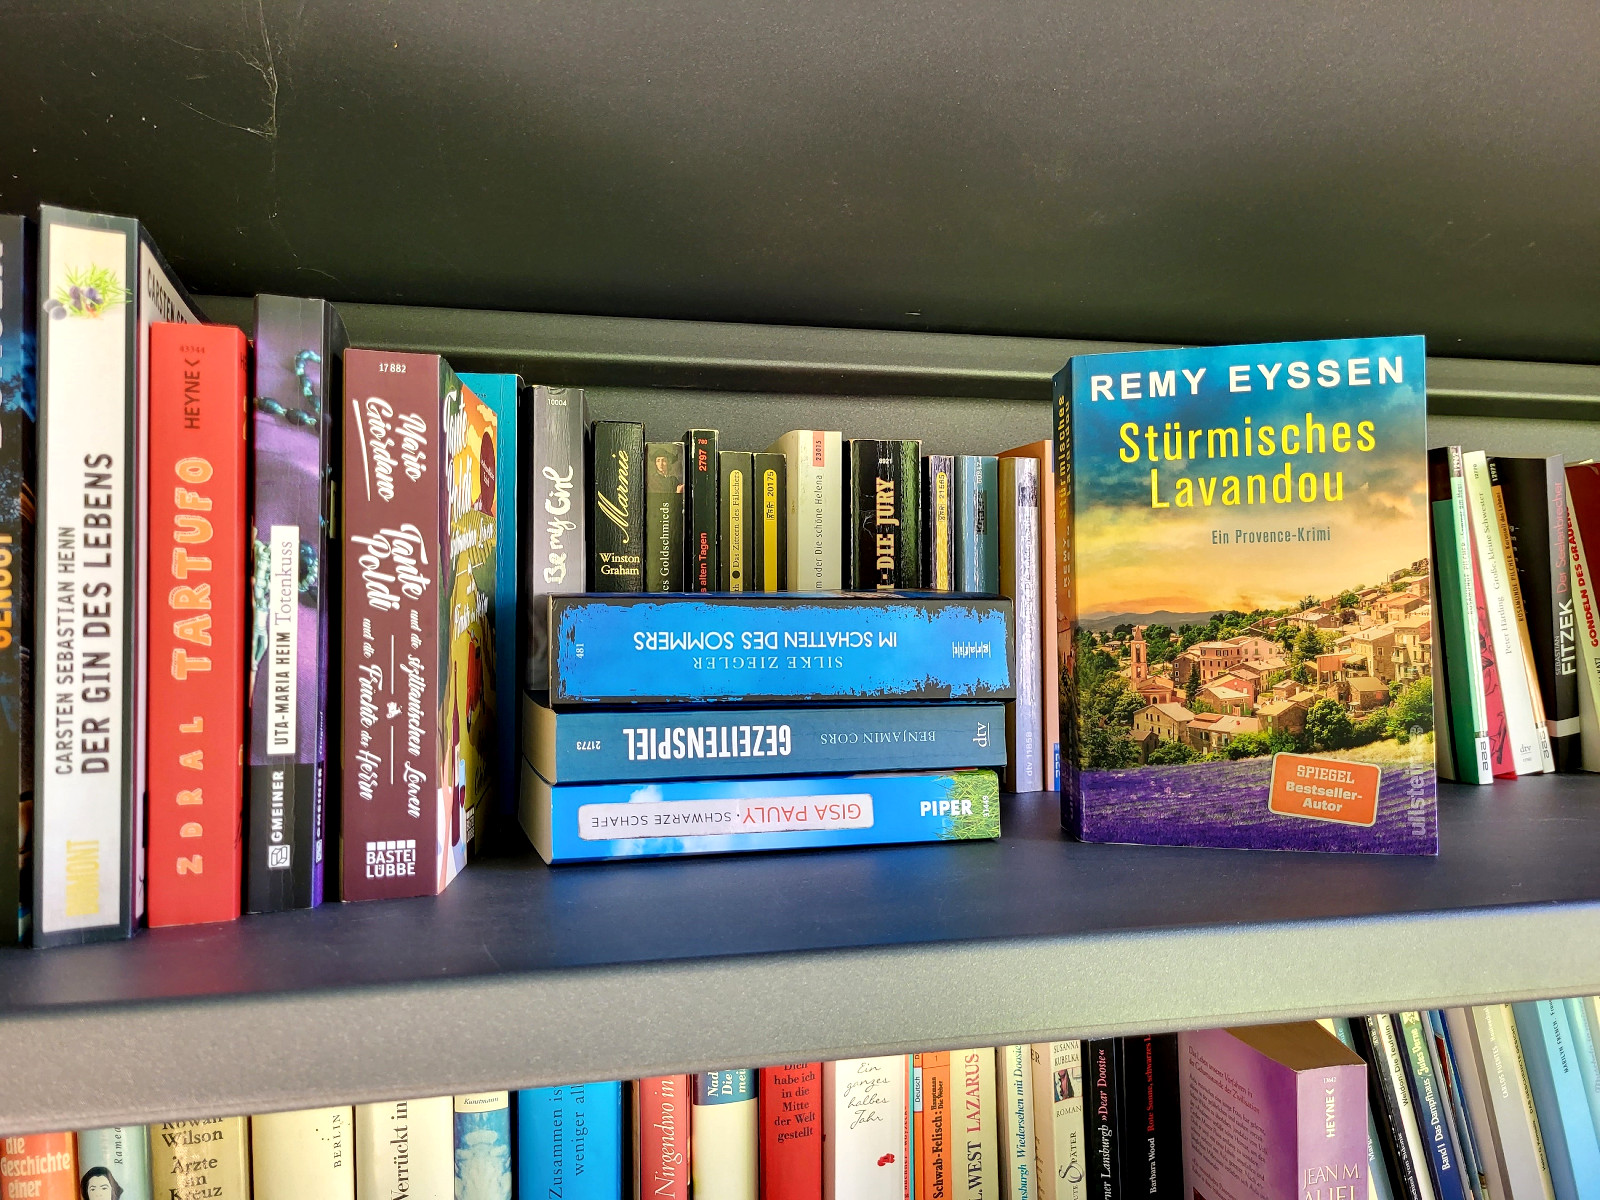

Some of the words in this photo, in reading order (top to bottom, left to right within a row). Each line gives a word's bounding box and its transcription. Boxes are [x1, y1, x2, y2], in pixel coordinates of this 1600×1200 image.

[1091, 368, 1207, 401] REMY
[1229, 356, 1403, 393] EYSSEN
[185, 371, 200, 429] HEYNE
[365, 397, 399, 502] Giordano
[395, 413, 427, 483] Mario
[1119, 412, 1377, 463] Stürmisches
[699, 449, 708, 471] 2797
[542, 465, 574, 516] Girl
[767, 471, 775, 497] 20175
[815, 474, 823, 505] Helena
[1150, 463, 1345, 509] Lavandou
[597, 450, 630, 544] Marnie
[876, 476, 899, 527] JURY
[84, 453, 113, 568] LEBENS
[732, 513, 740, 528] des
[815, 506, 823, 537] schöne
[1478, 492, 1492, 534] Schwester
[546, 516, 577, 551] my
[1212, 530, 1230, 544] Ein
[1235, 526, 1331, 544] Provence-Krimi
[1551, 481, 1567, 568] Seelenbrecher
[58, 527, 75, 573] HENN
[659, 502, 670, 580] Goldschmieds
[699, 532, 707, 561] Tagen
[732, 530, 740, 553] Zittern
[815, 541, 823, 555] Die
[876, 533, 895, 571] DIE
[1485, 535, 1496, 558] kleine
[169, 457, 213, 680] TARTUFO
[380, 523, 431, 601] Tante
[543, 552, 567, 585] Be
[600, 553, 640, 563] Winston
[600, 565, 640, 576] Graham
[732, 553, 740, 568] Das
[815, 557, 823, 581] oder
[275, 541, 293, 626] Totenkuss
[351, 534, 400, 611] Poldi
[1556, 572, 1568, 594] Der
[1574, 563, 1588, 588] DES
[83, 583, 112, 637] DES
[410, 609, 422, 631] und
[1496, 596, 1510, 632] Härtling
[1579, 589, 1600, 648] GONDELN
[57, 581, 75, 685] SEBASTIAN
[362, 618, 374, 641] und
[410, 633, 422, 650] die
[634, 631, 734, 651] SOMMERS
[741, 631, 778, 649] DES
[784, 631, 873, 649] SCHATTEN
[881, 631, 897, 646] IM
[1559, 599, 1577, 676] FITZEK
[275, 632, 290, 661] HEIM
[362, 642, 375, 659] die
[576, 643, 584, 659] 481
[1505, 632, 1513, 655] Peter
[1554, 635, 1562, 676] SEBASTIAN
[693, 656, 780, 669] ZIEGLER
[787, 656, 843, 669] SILKE
[82, 652, 111, 703] GIN
[274, 663, 290, 746] UTA-MARIA
[358, 664, 382, 730] Früchte
[400, 653, 427, 757] sizilianischen
[56, 693, 74, 775] CARSTEN
[81, 717, 110, 773] DER
[576, 741, 601, 750] 21773
[623, 724, 792, 761] GEZEITENSPIEL
[820, 733, 858, 745] CORS
[870, 731, 935, 744] BENJAMIN
[972, 721, 989, 748] dtv
[355, 750, 381, 801] Herrn
[1025, 762, 1033, 777] dtv
[1296, 764, 1356, 785] SPIEGEL
[403, 760, 427, 819] Löwen
[1285, 781, 1363, 801] Bestseller-
[272, 770, 284, 841] GMEINER
[654, 811, 731, 825] SCHWARZE
[743, 804, 808, 824] PAULY
[816, 802, 861, 818] GISA
[920, 800, 973, 817] PIPER
[1302, 798, 1342, 813] Autor
[366, 848, 415, 864] BASTEI
[366, 862, 415, 878] LÜBBE
[1053, 1041, 1079, 1054] SUSANNA
[1384, 1024, 1399, 1058] Teufelin
[1411, 1027, 1422, 1052] Verne
[857, 1062, 881, 1074] Ein
[1012, 1046, 1023, 1078] Doosie
[1054, 1053, 1080, 1067] KUBELKA
[1145, 1043, 1153, 1082] schwarzes
[1393, 1060, 1402, 1073] Die
[1558, 1046, 1570, 1073] MARILYN
[655, 1080, 675, 1101] in
[722, 1073, 733, 1096] Die
[774, 1072, 798, 1086] habe
[802, 1071, 816, 1082] ich
[843, 1077, 891, 1098] ganzes
[1015, 1080, 1024, 1096] mit
[1496, 1073, 1509, 1099] CARLOS
[781, 1088, 792, 1098] in
[795, 1086, 810, 1097] die
[848, 1095, 890, 1109] halbes
[964, 1053, 981, 1133] LAZARUS
[1146, 1083, 1154, 1111] Sonne,
[1423, 1078, 1440, 1125] Dampfhaus
[391, 1101, 408, 1121] in
[774, 1116, 792, 1127] der
[794, 1112, 816, 1125] Welt
[782, 1101, 810, 1113] Mitte
[1056, 1104, 1082, 1118] ROMAN
[1325, 1096, 1336, 1138] HEYNE
[849, 1110, 884, 1130] Jahr
[1016, 1098, 1026, 1158] Wiedersehen
[1146, 1112, 1155, 1132] Rote
[6, 1137, 25, 1153] die
[162, 1127, 224, 1148] Wilson
[333, 1113, 342, 1168] BERLIN
[571, 1111, 589, 1176] weniger
[777, 1126, 814, 1144] gestellt
[1434, 1124, 1444, 1142] Das
[549, 1108, 563, 1200] Zusammen
[654, 1104, 683, 1199] Nirgendwo
[1098, 1124, 1113, 1178] Lansburgh
[1147, 1138, 1156, 1161] Wood
[1441, 1152, 1451, 1171] Band
[0, 1151, 71, 1178] Geschichte
[171, 1155, 218, 1174] Ärzte
[390, 1125, 408, 1200] Verrückt
[8, 1178, 42, 1199] einer
[1149, 1161, 1158, 1194] Barbara
[1303, 1164, 1338, 1189] JEAN
[170, 1186, 223, 1200] Kreuz
